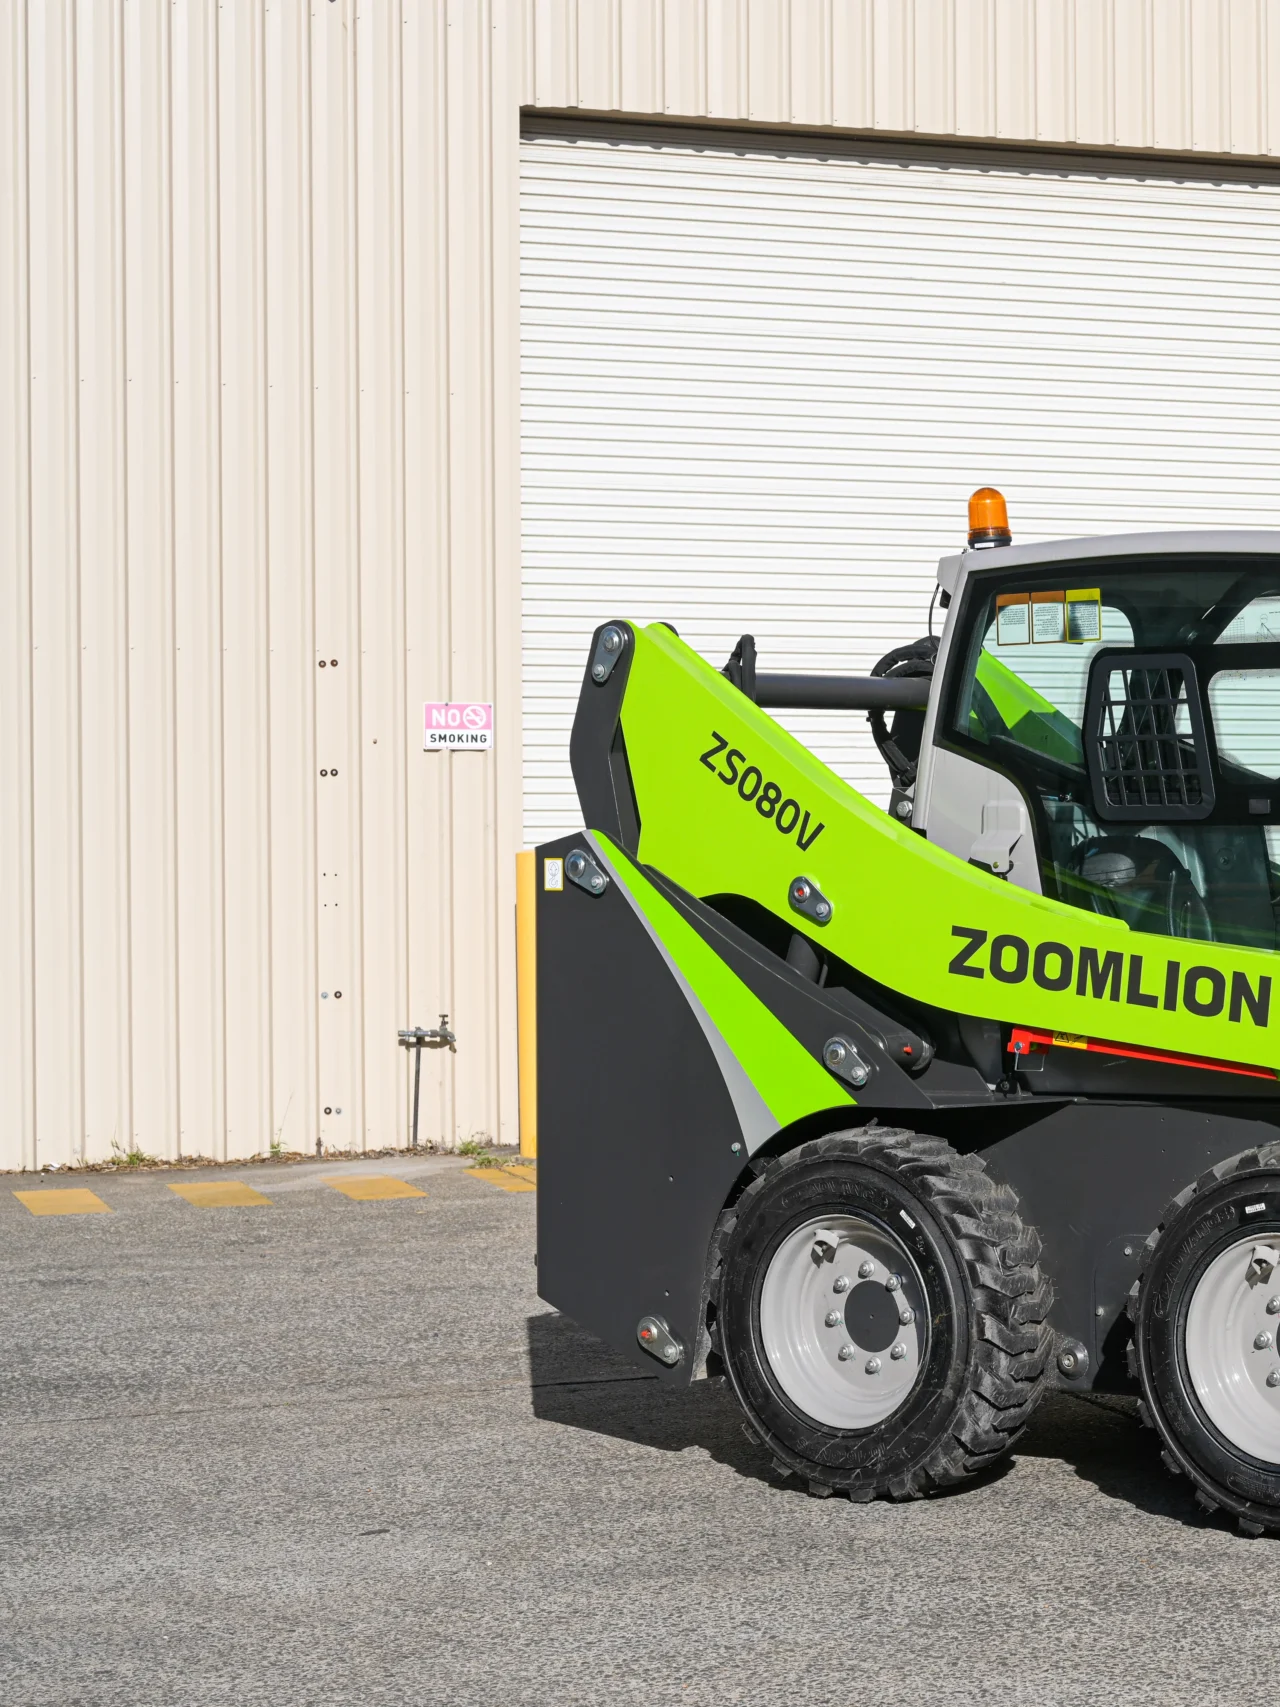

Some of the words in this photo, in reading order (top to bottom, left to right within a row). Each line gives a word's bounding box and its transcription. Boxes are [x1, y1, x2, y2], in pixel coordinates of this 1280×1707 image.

[430, 733, 487, 743] SMOKING
[431, 708, 461, 727] NO
[699, 730, 825, 852] ZS080V
[948, 925, 1272, 1027] ZOOMLION
